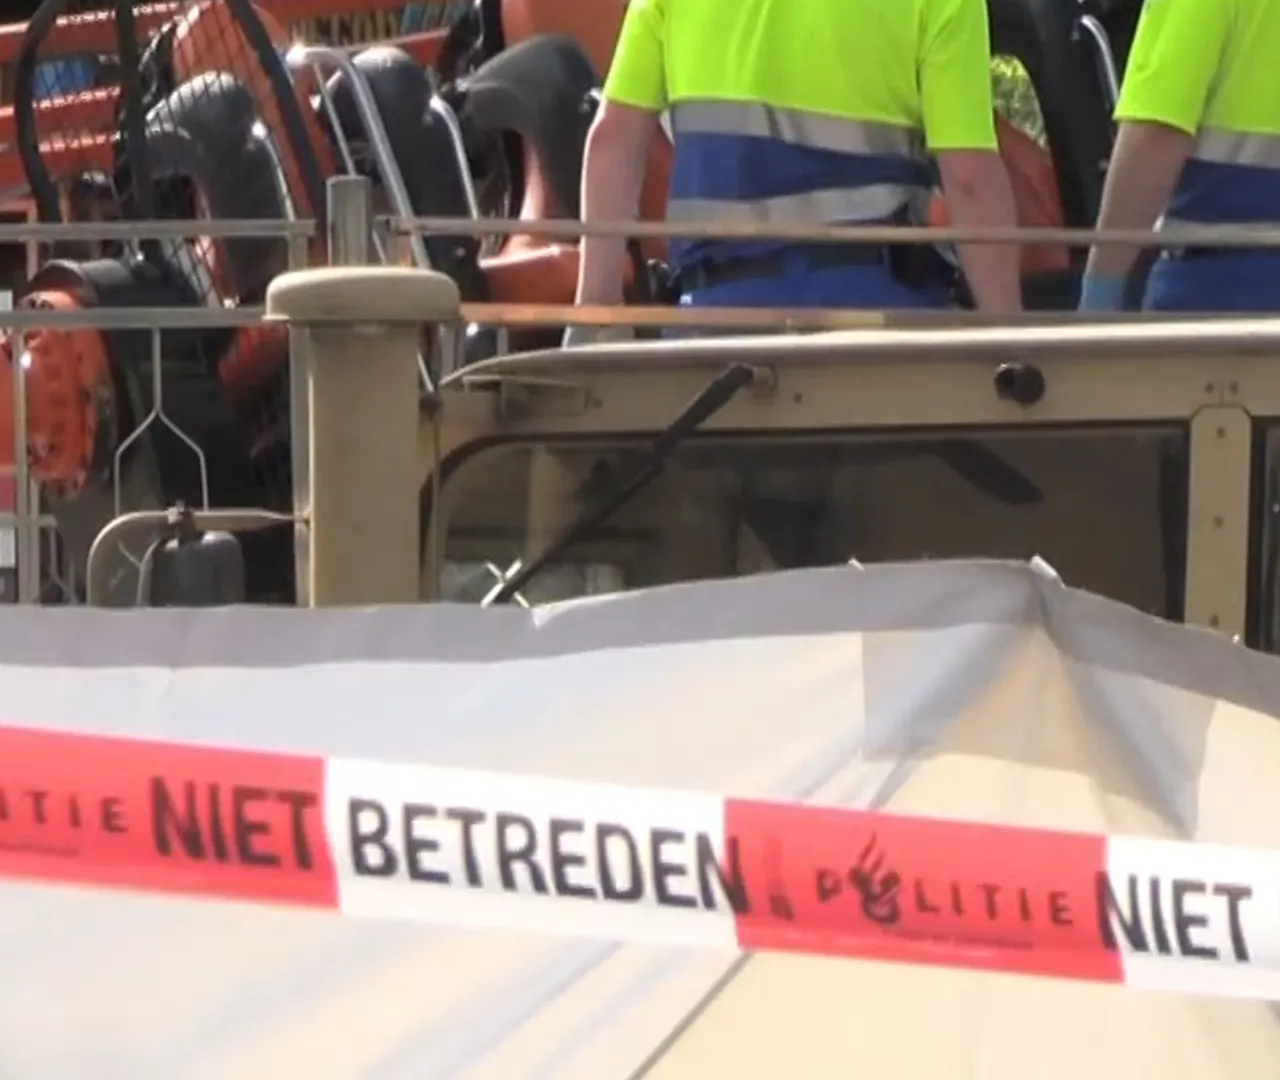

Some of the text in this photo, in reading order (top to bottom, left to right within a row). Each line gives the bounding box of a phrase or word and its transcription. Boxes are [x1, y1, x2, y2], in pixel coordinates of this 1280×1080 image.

[150, 776, 318, 871] NIET
[347, 797, 751, 915] BETREDEN
[1095, 870, 1253, 963] NIET
